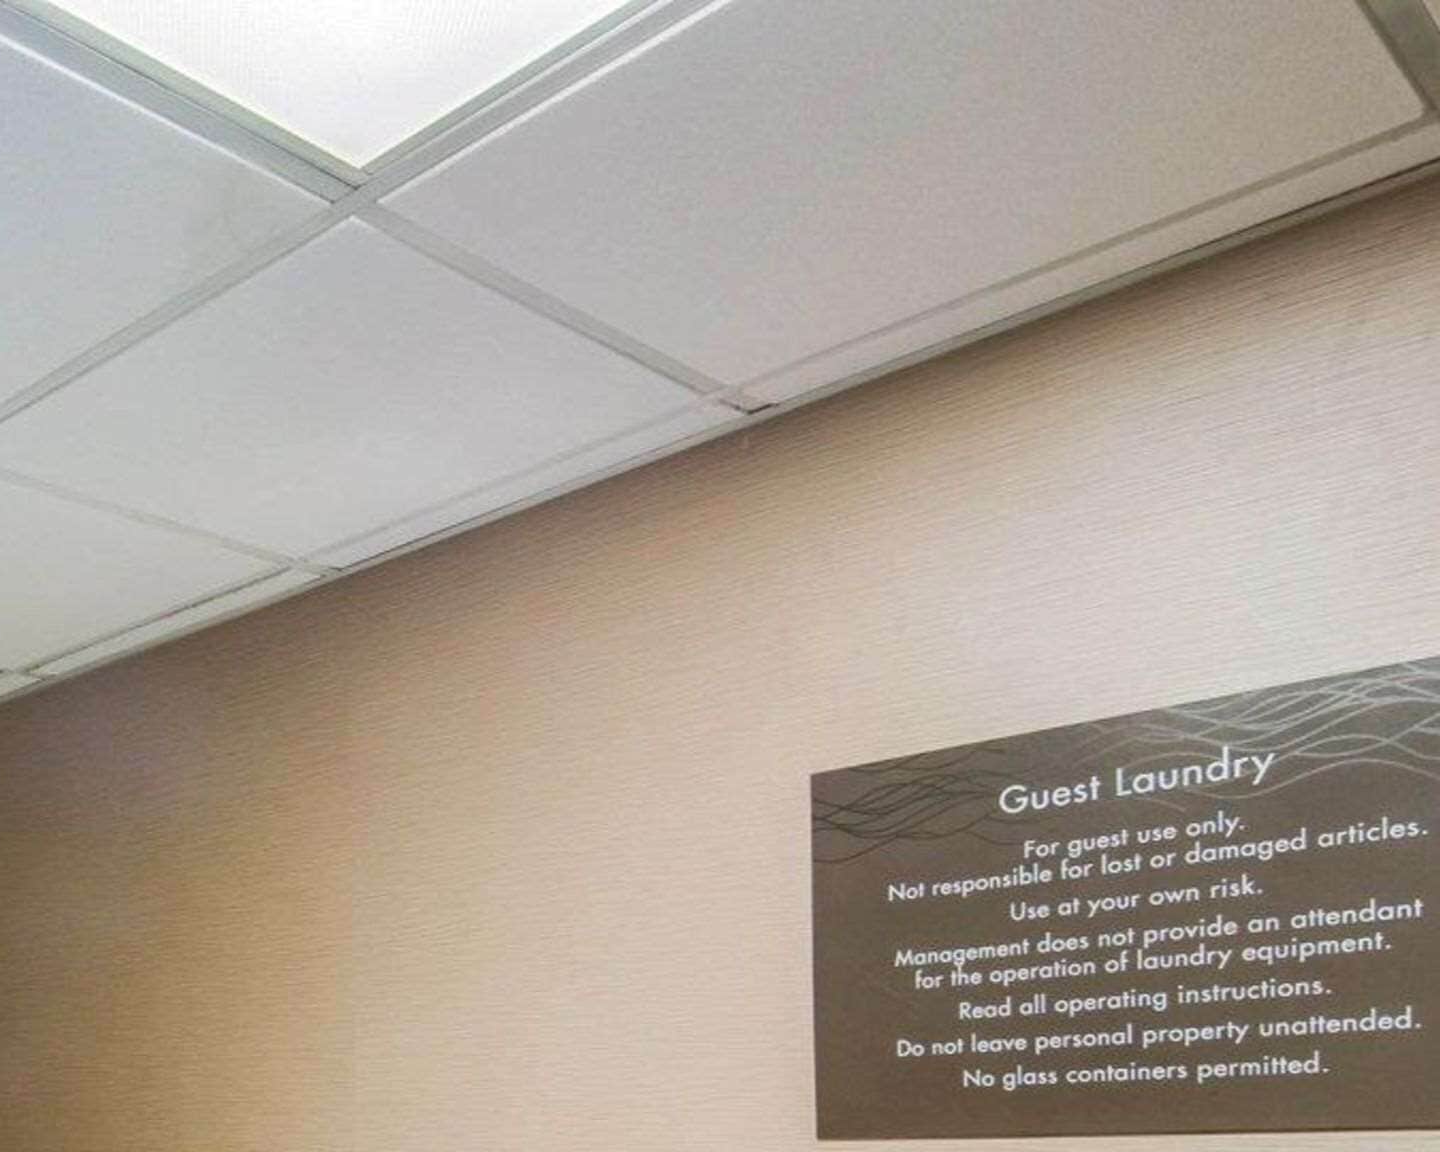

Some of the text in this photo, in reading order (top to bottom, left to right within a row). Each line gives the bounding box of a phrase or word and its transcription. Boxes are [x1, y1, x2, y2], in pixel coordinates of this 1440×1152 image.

[998, 745, 1278, 814] Guest Laundry
[887, 815, 1430, 902] Not responsible for lost or damaged articles.
[1023, 810, 1246, 860] For guest use only.
[1009, 873, 1264, 922] Use at your own risk.
[893, 897, 1426, 968] Management does not provide an attendant
[914, 931, 1393, 990] for the operation of laundry equipment.
[958, 977, 1333, 1020] Read all operating instructions.
[896, 1004, 1423, 1058] Do not leave personal property unattended.
[962, 1049, 1331, 1092] No glass containers permitted.
